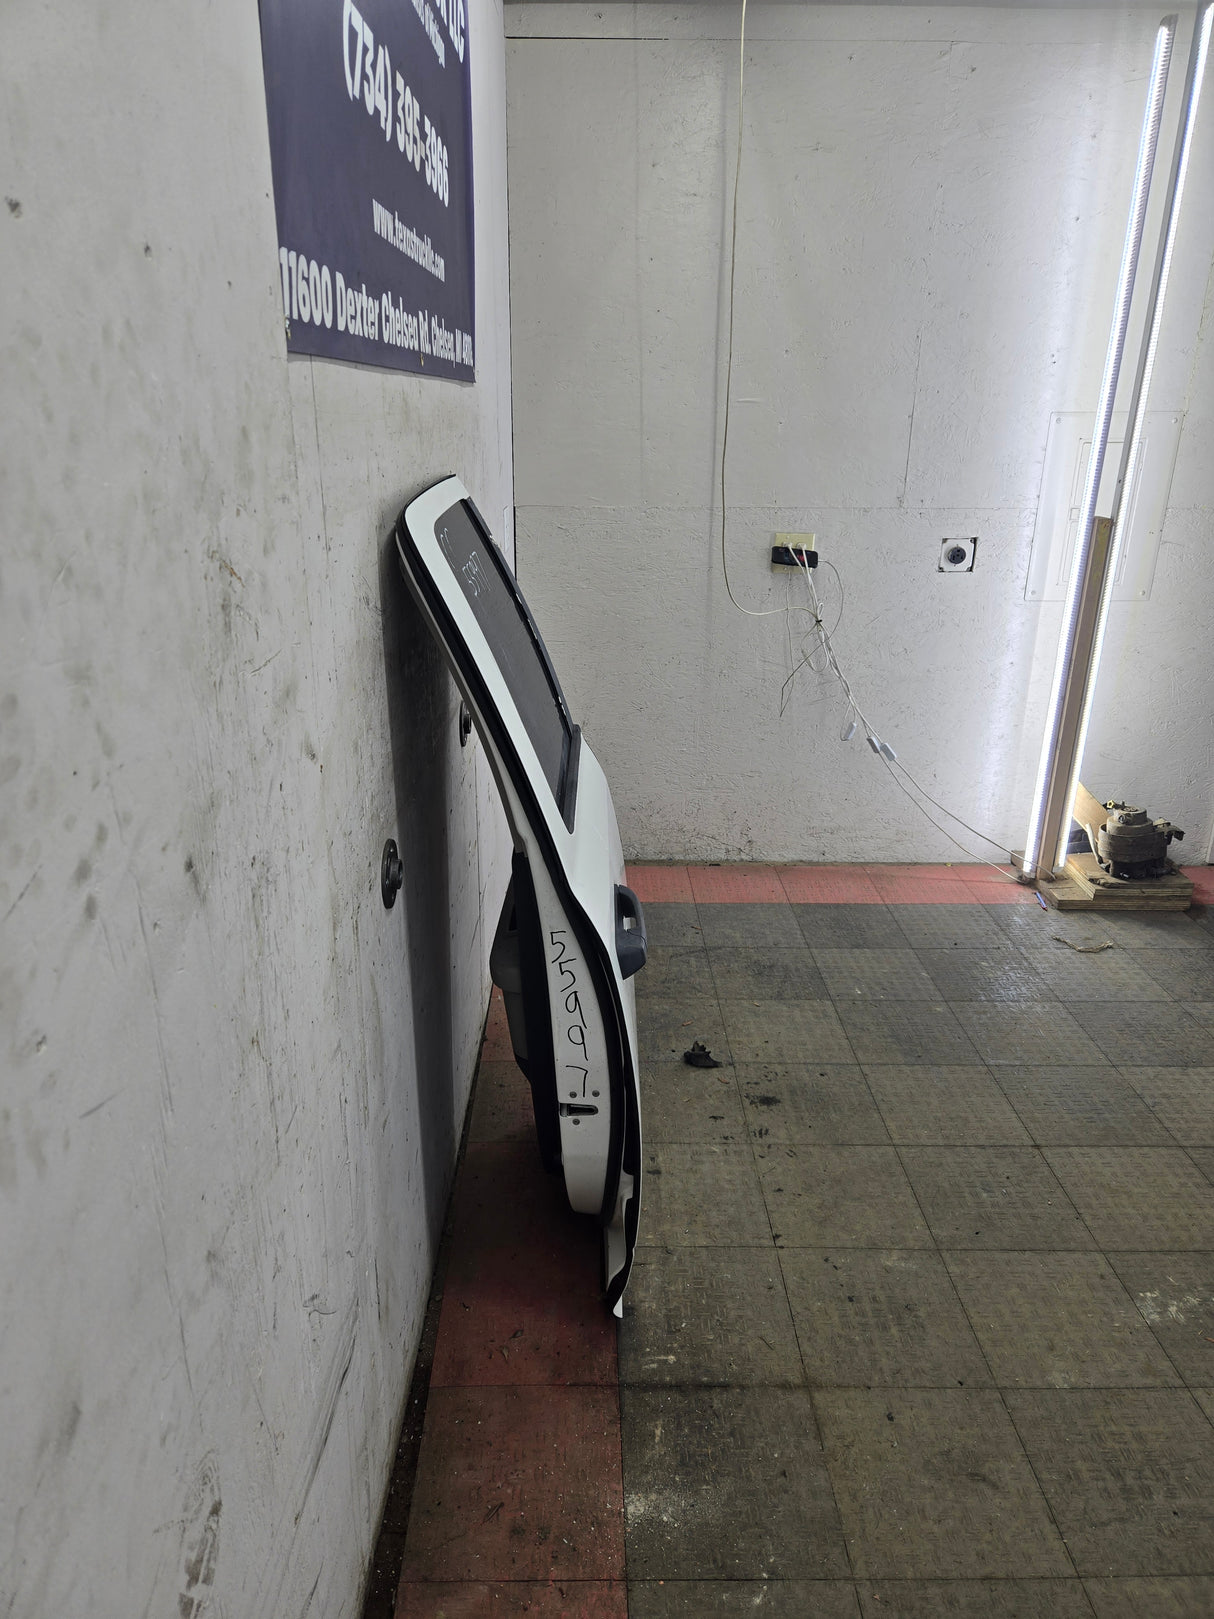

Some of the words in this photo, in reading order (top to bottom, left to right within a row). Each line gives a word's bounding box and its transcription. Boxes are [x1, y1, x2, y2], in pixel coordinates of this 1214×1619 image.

[343, 0, 392, 142] (734)
[396, 70, 449, 208] 395-3966
[280, 247, 332, 329] 11600
[336, 271, 379, 341] Dexter
[381, 291, 419, 352] Chelsea
[418, 310, 431, 355] Rd.
[550, 930, 588, 1098] 55997
